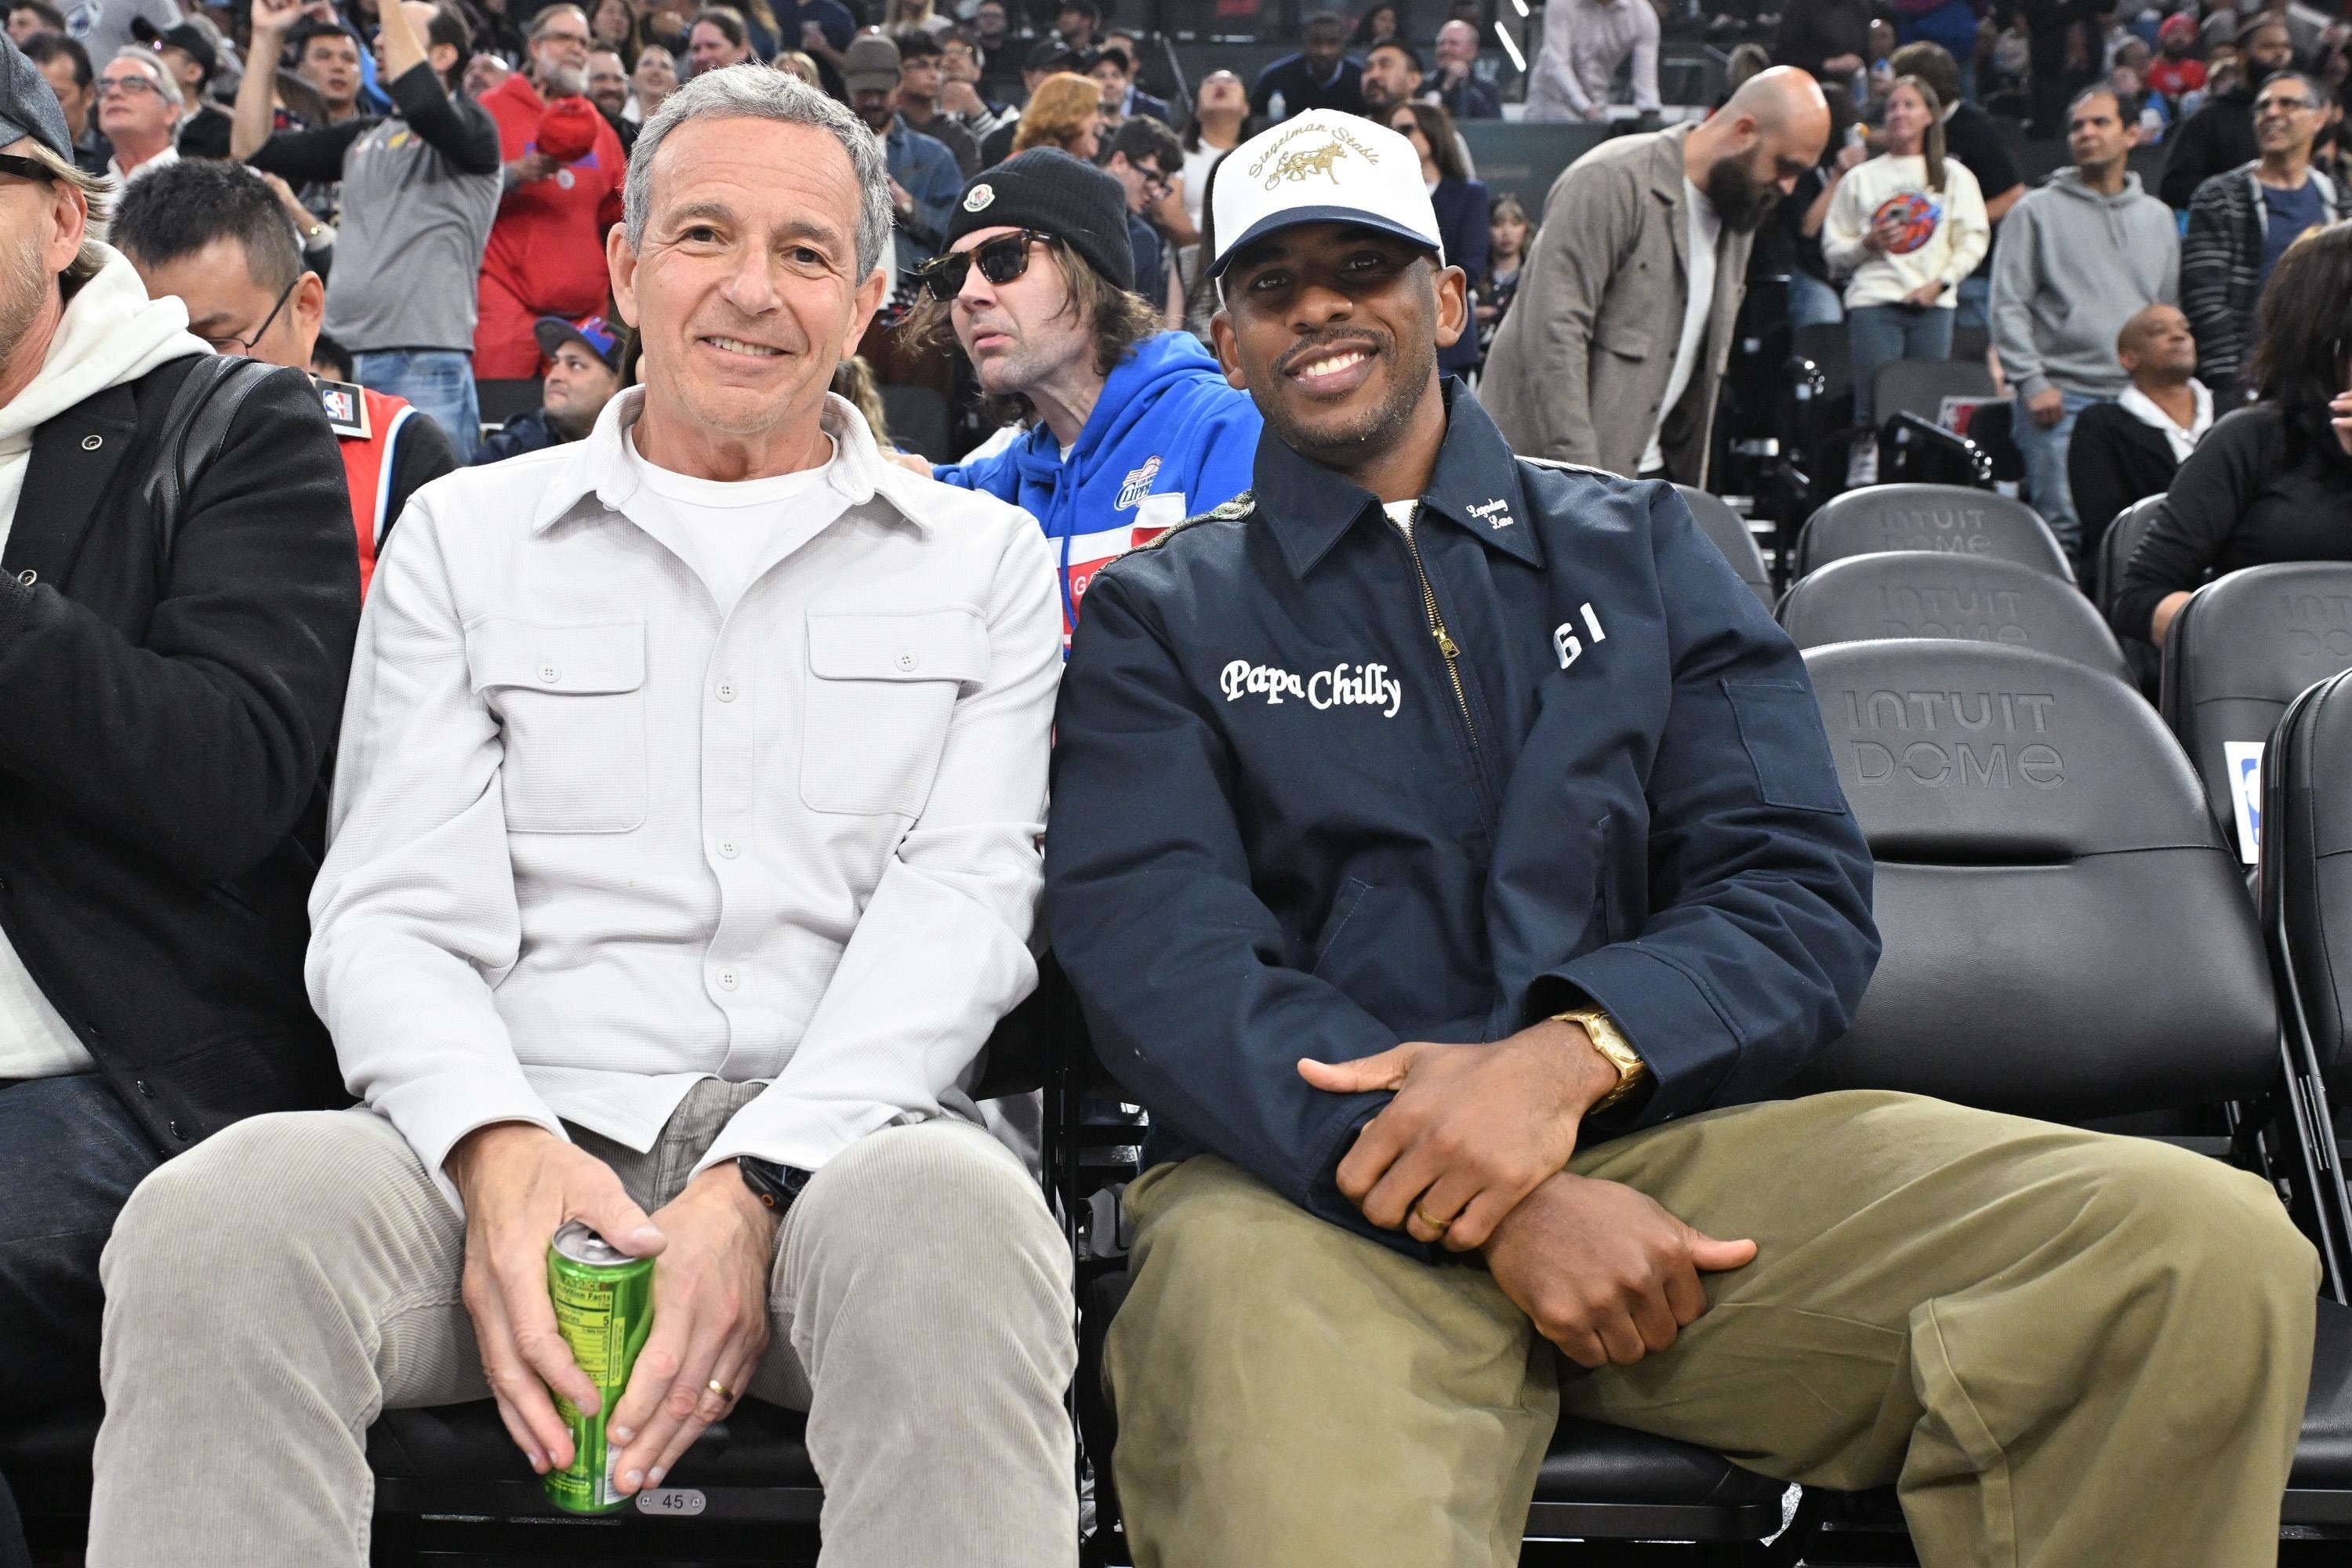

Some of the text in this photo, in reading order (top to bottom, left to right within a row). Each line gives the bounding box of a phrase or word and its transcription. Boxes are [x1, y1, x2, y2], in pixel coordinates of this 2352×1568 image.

[1553, 602, 1606, 670] 61
[1220, 659, 1402, 718] Papa Chilly
[588, 1292, 611, 1301] Facts
[603, 1316, 609, 1327] 5
[662, 1494, 684, 1509] 45
